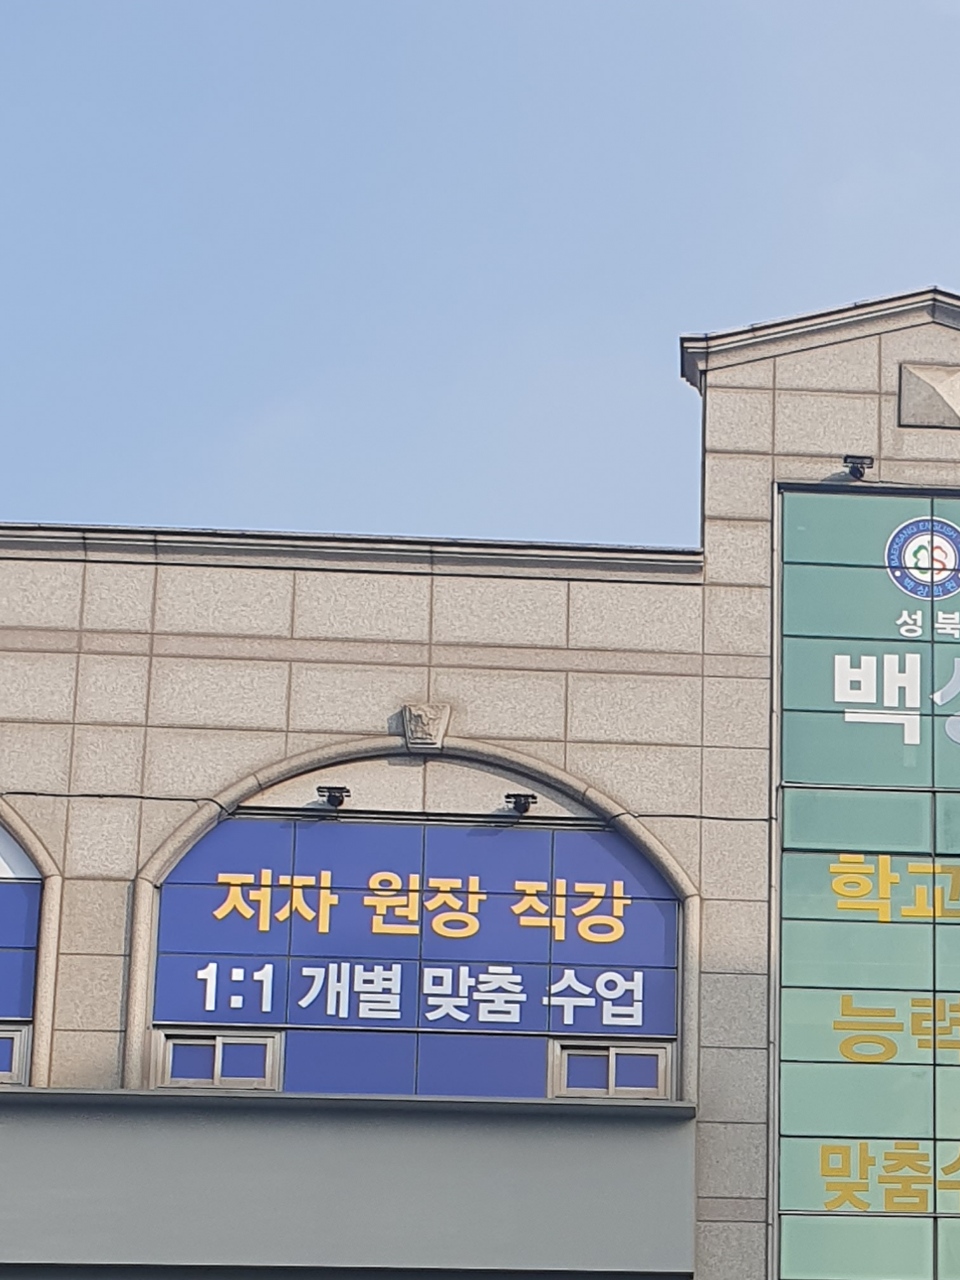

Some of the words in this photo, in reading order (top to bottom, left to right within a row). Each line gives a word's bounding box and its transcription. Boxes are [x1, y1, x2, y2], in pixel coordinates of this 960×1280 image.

[212, 869, 338, 934] 저자
[362, 871, 487, 939] 원장
[510, 878, 632, 943] 직강
[196, 962, 275, 1013] 1:1
[298, 963, 402, 1021] 개별
[422, 965, 528, 1024] 맞춤
[542, 969, 644, 1027] 수업
